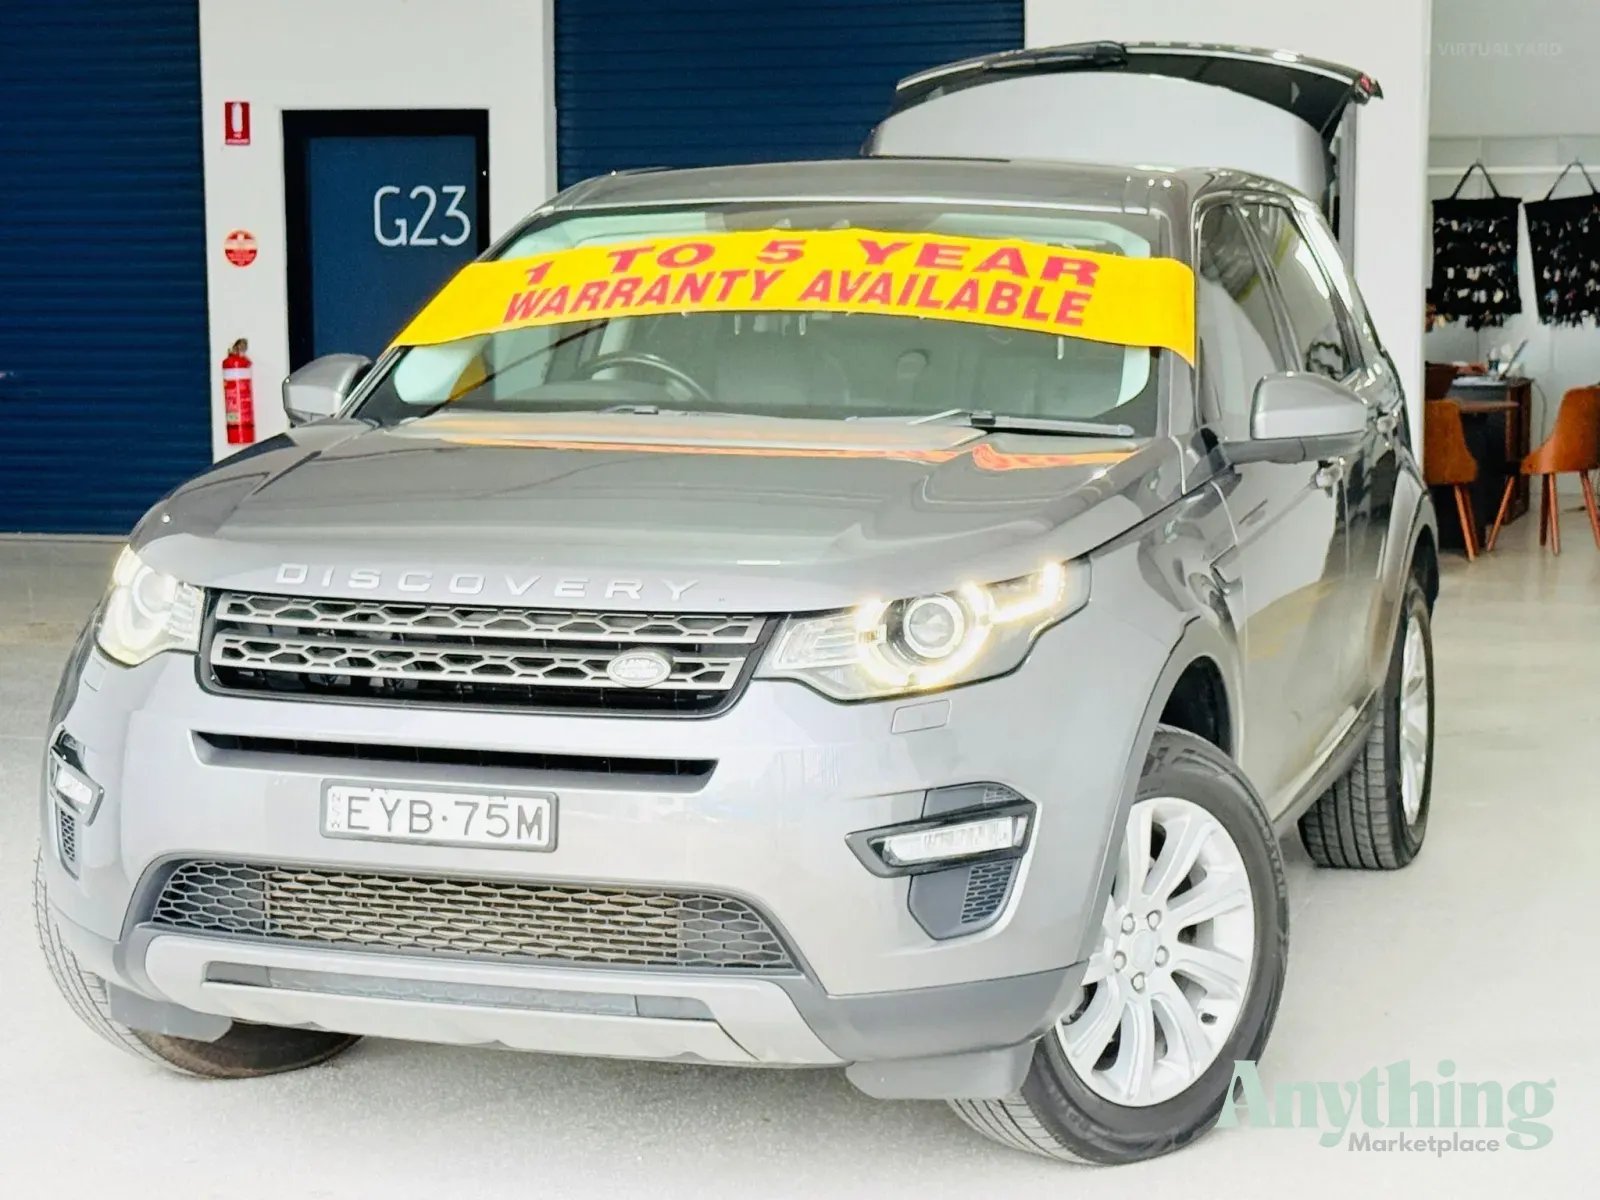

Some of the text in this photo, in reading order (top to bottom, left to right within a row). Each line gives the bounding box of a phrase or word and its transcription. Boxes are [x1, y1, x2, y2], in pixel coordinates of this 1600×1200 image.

[373, 184, 472, 247] G23
[524, 238, 1100, 288] 1 TO 5 YEAR
[502, 269, 1093, 327] WARRANTY AVAILABLE
[275, 562, 699, 601] DISCOVERY
